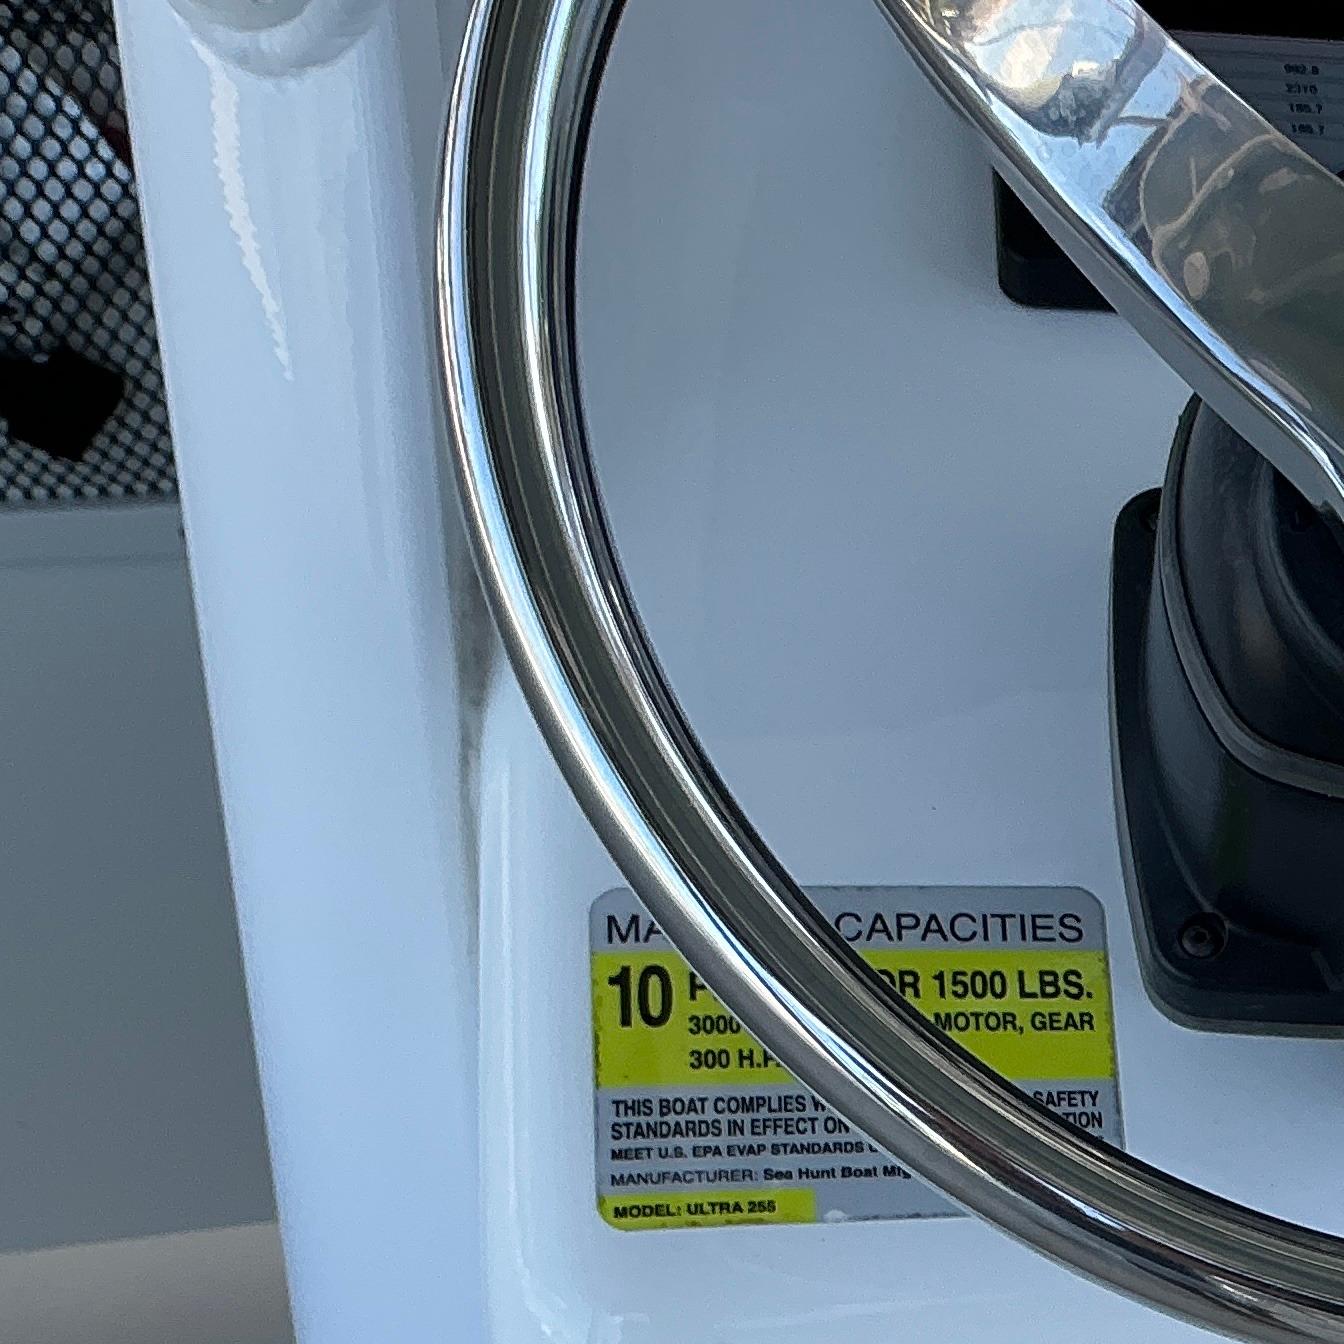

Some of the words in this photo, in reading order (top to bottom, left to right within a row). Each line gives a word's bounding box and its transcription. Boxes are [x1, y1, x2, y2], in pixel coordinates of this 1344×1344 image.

[834, 911, 1085, 944] CAPACITIES
[608, 963, 674, 1029] 10
[932, 969, 1008, 1000] 1500
[1018, 968, 1094, 1000] LBS.
[933, 1011, 1025, 1035] MOTOR,
[1031, 1011, 1095, 1033] GEAR
[689, 1048, 730, 1070] 300
[612, 1098, 654, 1118] THIS
[659, 1096, 709, 1118] BOAT
[714, 1095, 807, 1116] COMPLIES
[1034, 1089, 1100, 1108] SAFETY
[611, 1118, 723, 1141] STANDARDS
[727, 1118, 746, 1137] IN
[750, 1116, 819, 1136] EFFECT
[823, 1115, 850, 1135] ON
[611, 1147, 653, 1161] MEET
[658, 1146, 688, 1159] U.S.
[692, 1145, 723, 1158] EPA
[726, 1143, 767, 1158] EVAP
[771, 1141, 865, 1156] STANDARDS
[610, 1168, 759, 1188] MANUFACTURER:
[763, 1167, 793, 1180] Sea
[798, 1166, 837, 1180] Hunt
[841, 1165, 879, 1179] Boat
[613, 1203, 683, 1219] MODEL:
[686, 1201, 744, 1216] ULTRA
